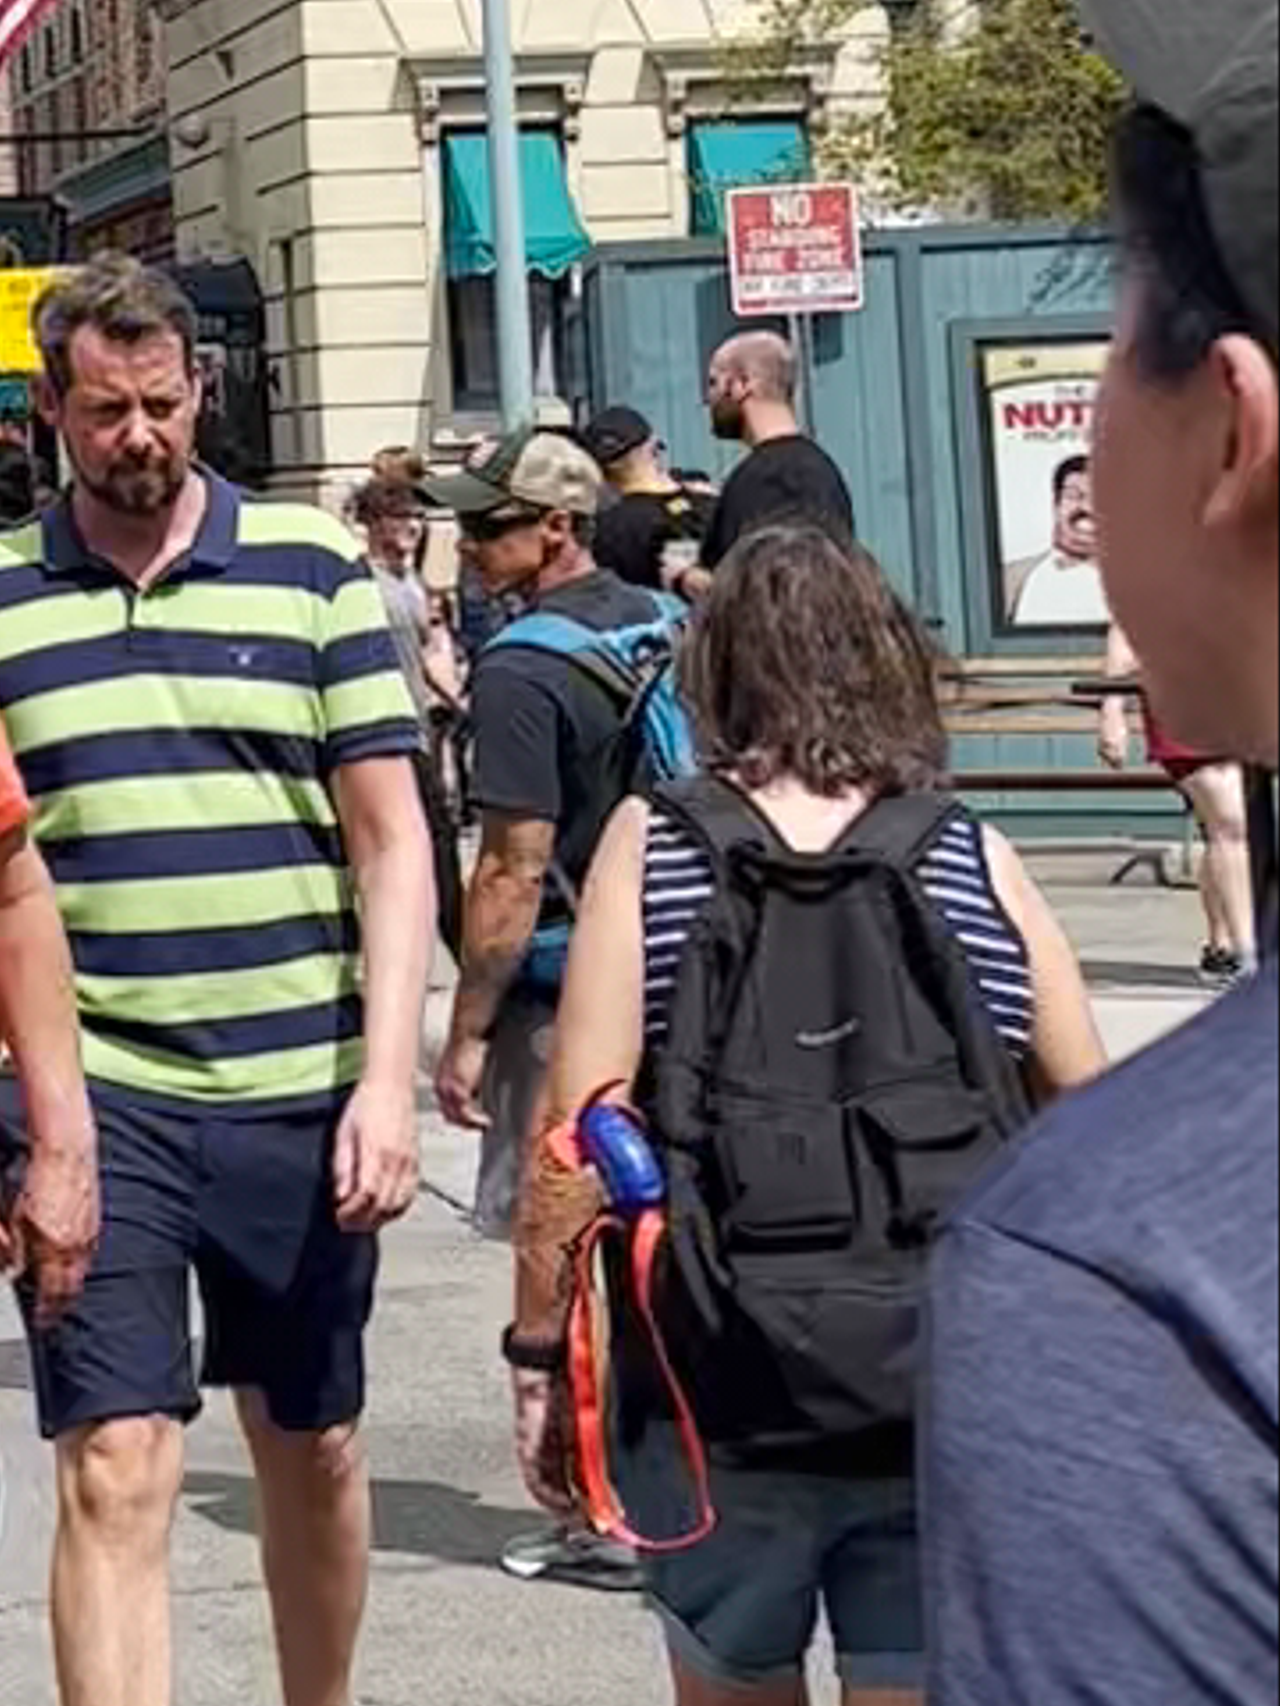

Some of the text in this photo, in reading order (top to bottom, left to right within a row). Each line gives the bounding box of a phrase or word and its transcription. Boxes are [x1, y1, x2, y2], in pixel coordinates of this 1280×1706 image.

[770, 192, 814, 227] NO
[745, 225, 843, 250] STANDING
[741, 248, 842, 274] FIRE ZONE
